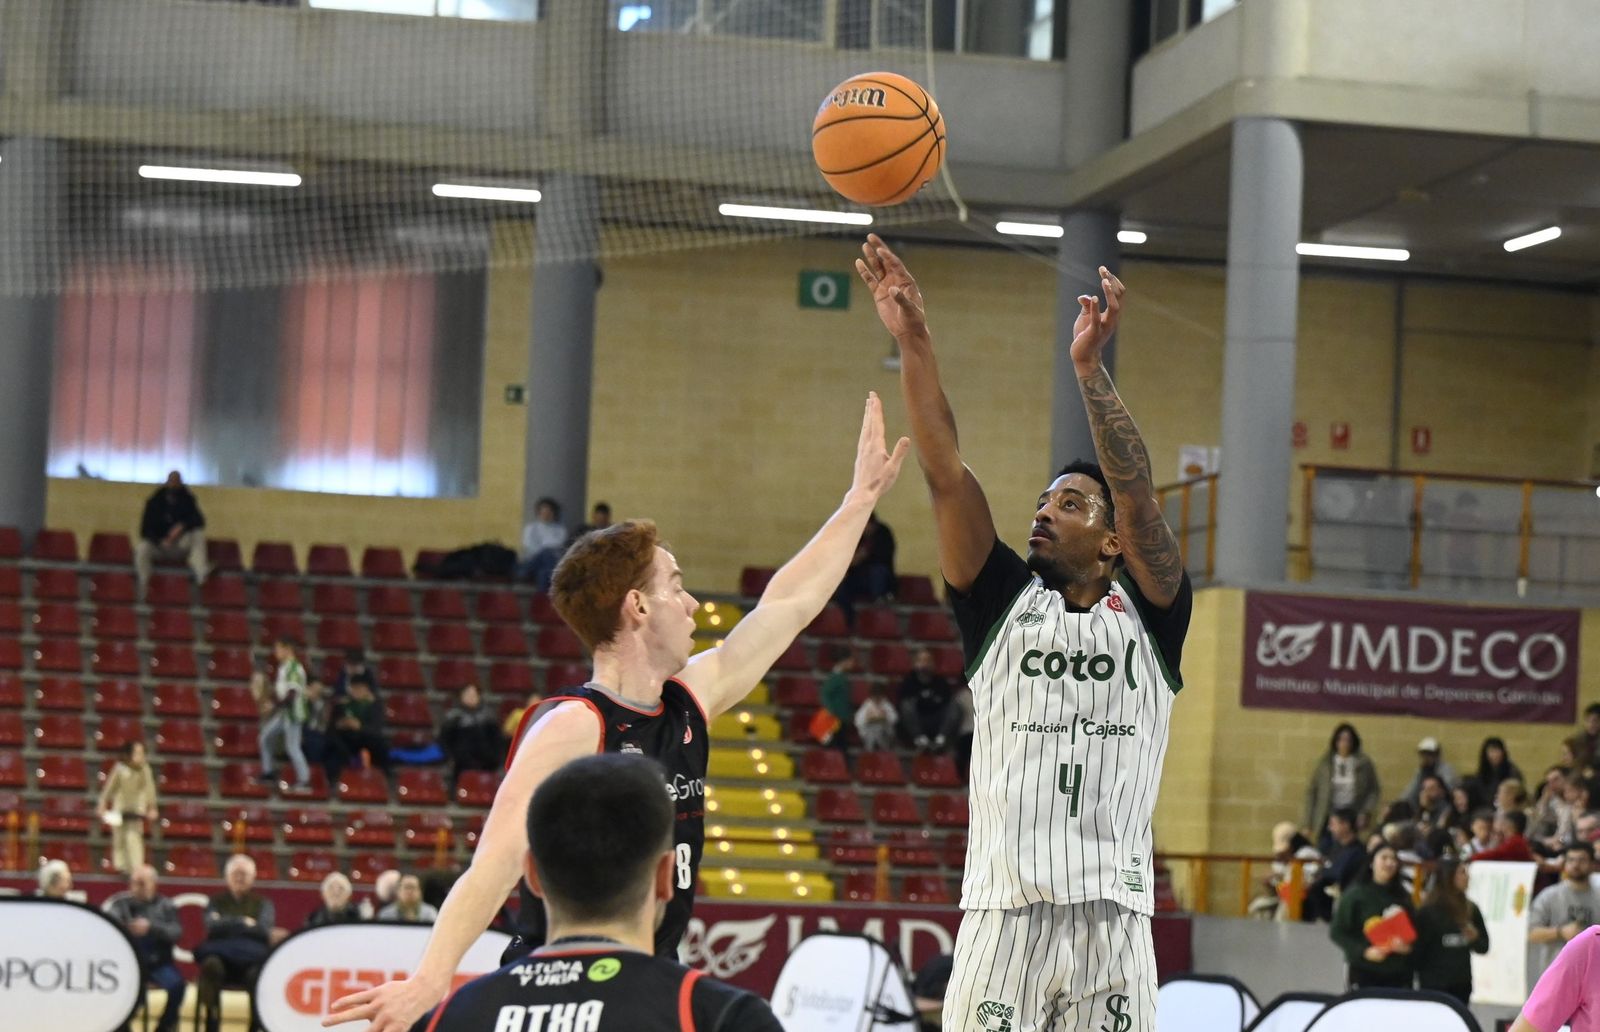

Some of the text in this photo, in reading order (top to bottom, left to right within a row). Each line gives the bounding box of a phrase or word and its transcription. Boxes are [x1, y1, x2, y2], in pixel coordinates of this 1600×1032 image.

[1020, 649, 1115, 682] coto
[1330, 622, 1567, 681] IMDECO
[1323, 678, 1398, 700] Municipal
[1400, 684, 1421, 699] de
[1011, 721, 1068, 733] Fundación
[1059, 763, 1083, 818] 4
[0, 956, 120, 994] POLIS
[494, 999, 604, 1032] ATXA
